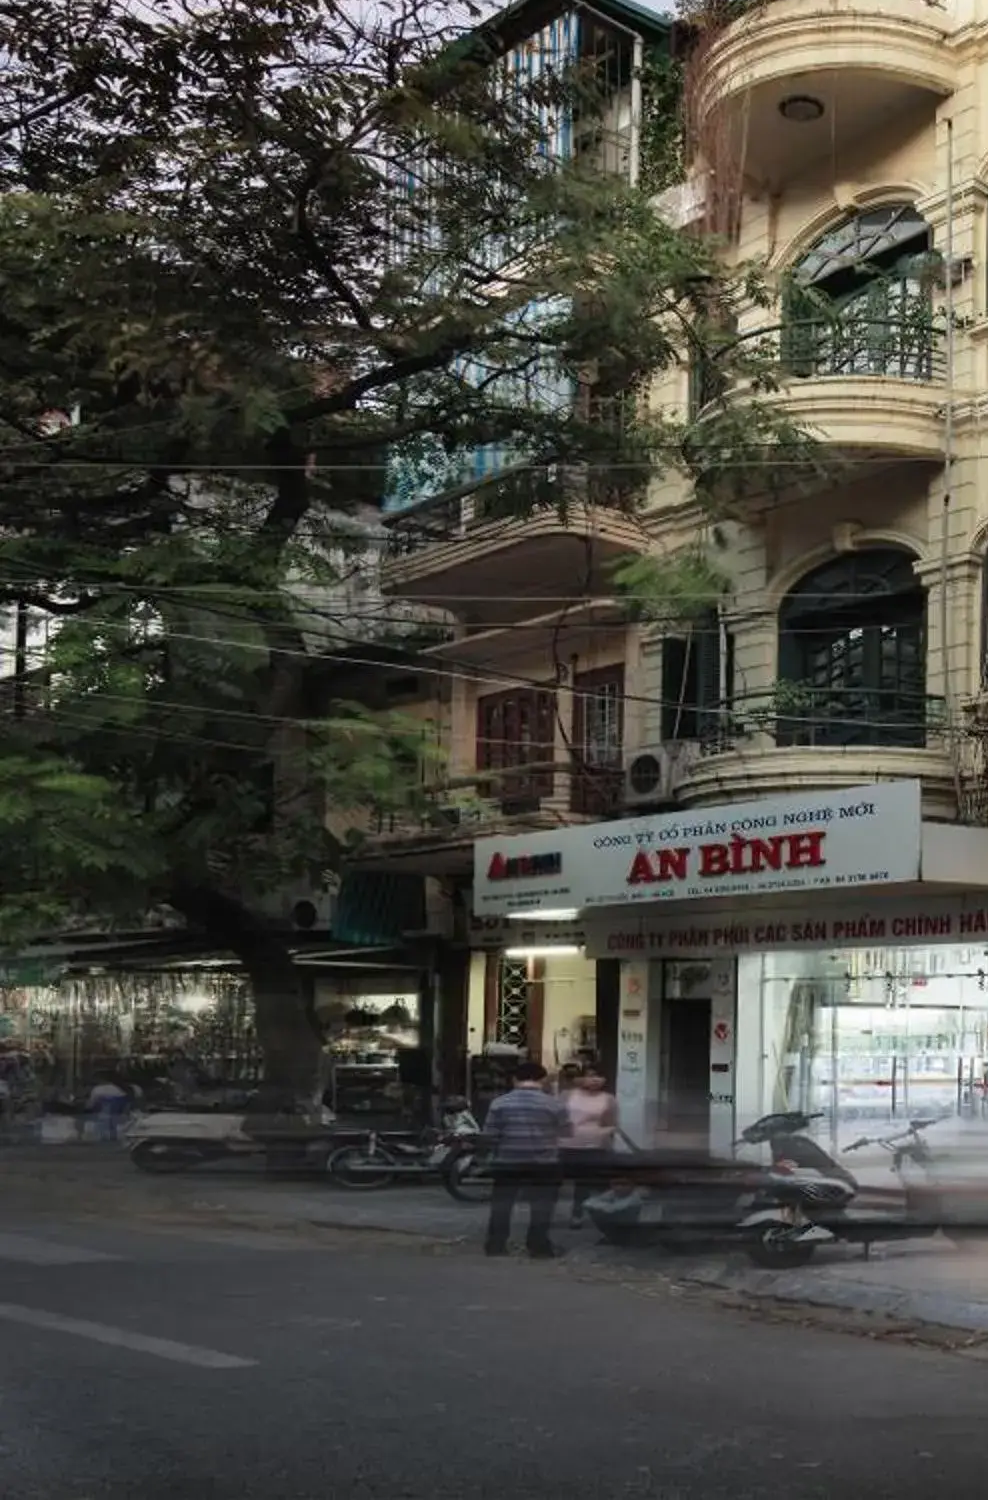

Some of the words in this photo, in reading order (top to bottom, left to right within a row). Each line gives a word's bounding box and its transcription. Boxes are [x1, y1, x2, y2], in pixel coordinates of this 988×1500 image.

[593, 833, 631, 849] CÔNG
[730, 814, 777, 831] CÔNG
[626, 846, 690, 884] AN
[698, 831, 827, 877] BÌNH
[891, 912, 950, 937] CHÍNH
